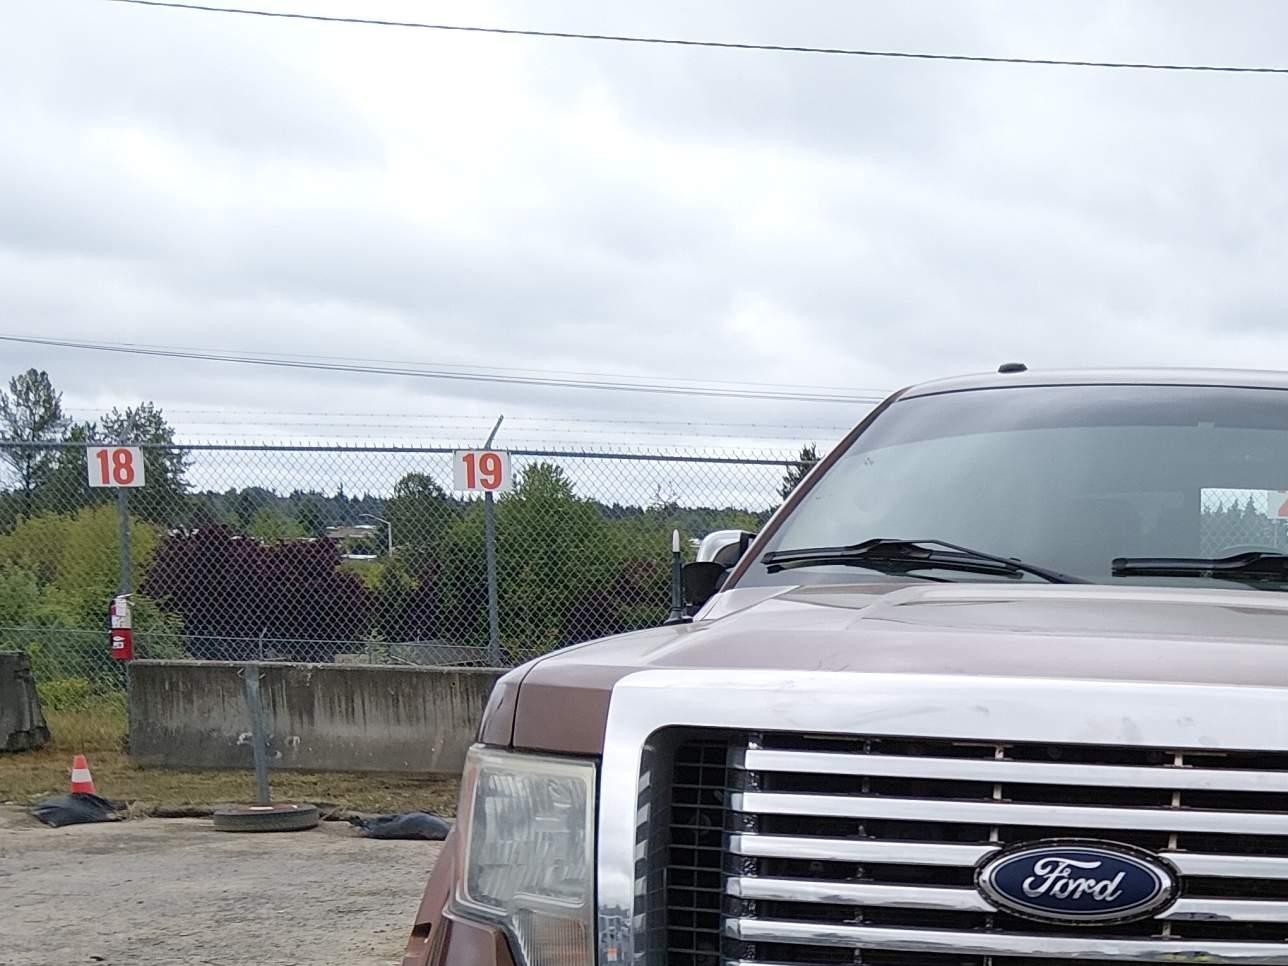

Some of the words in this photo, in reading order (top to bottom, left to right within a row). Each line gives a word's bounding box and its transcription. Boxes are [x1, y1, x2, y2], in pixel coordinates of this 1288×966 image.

[96, 448, 135, 485] 18
[462, 452, 502, 490] 19
[1023, 857, 1126, 901] Ford
